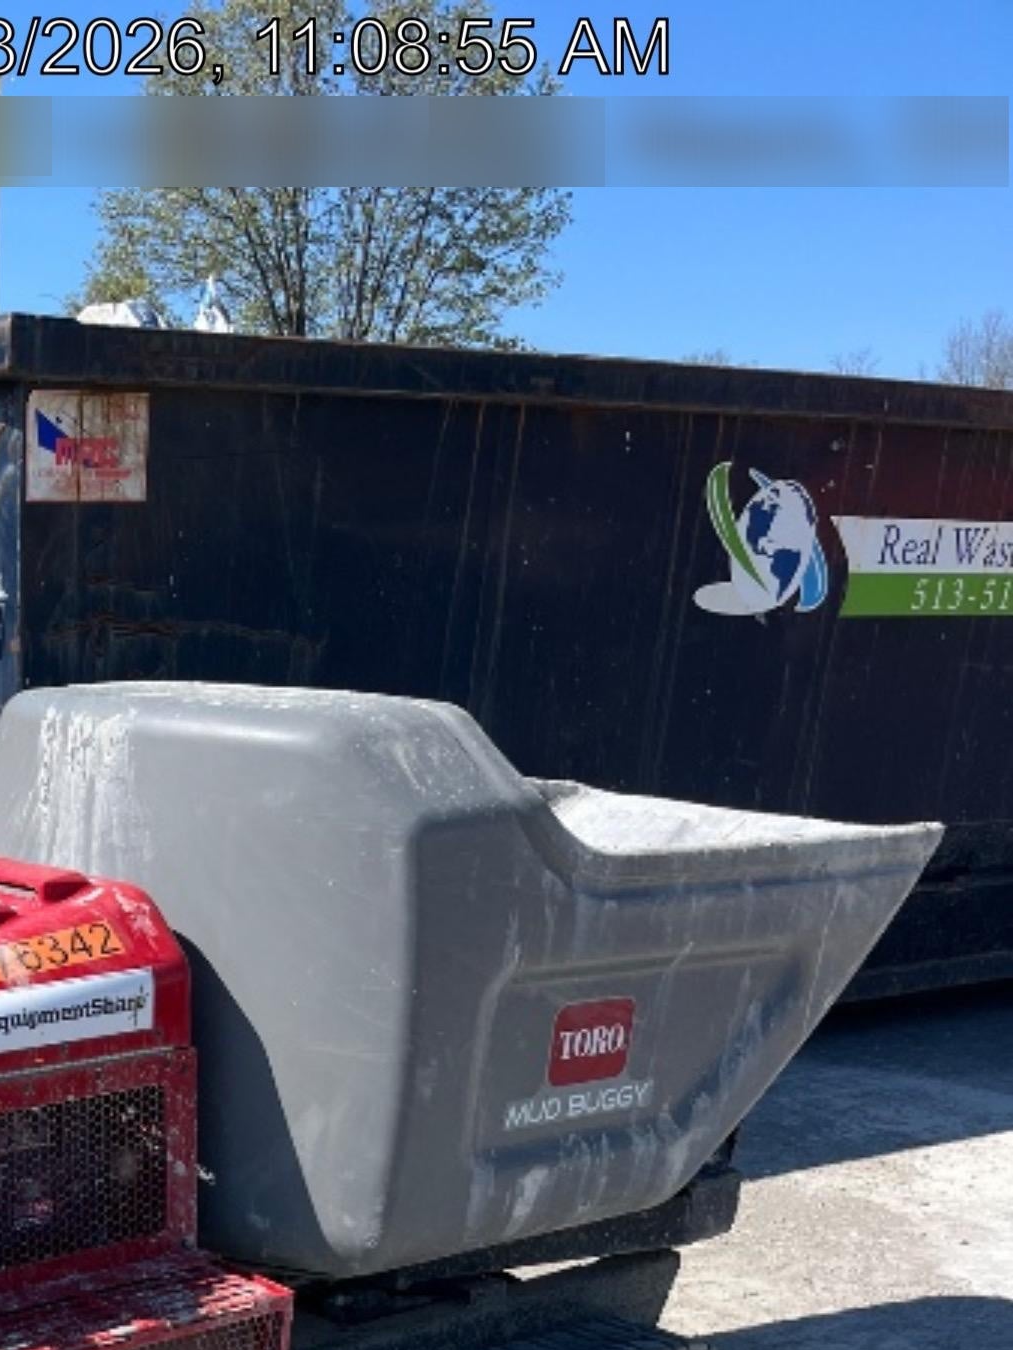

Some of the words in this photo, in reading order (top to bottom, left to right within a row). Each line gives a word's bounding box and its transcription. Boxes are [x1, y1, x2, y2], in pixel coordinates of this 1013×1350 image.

[877, 523, 945, 566] Real
[910, 578, 1012, 611] 513-51
[559, 1022, 625, 1060] TORO
[504, 1097, 562, 1131] MUD
[567, 1080, 650, 1118] BUGGY
